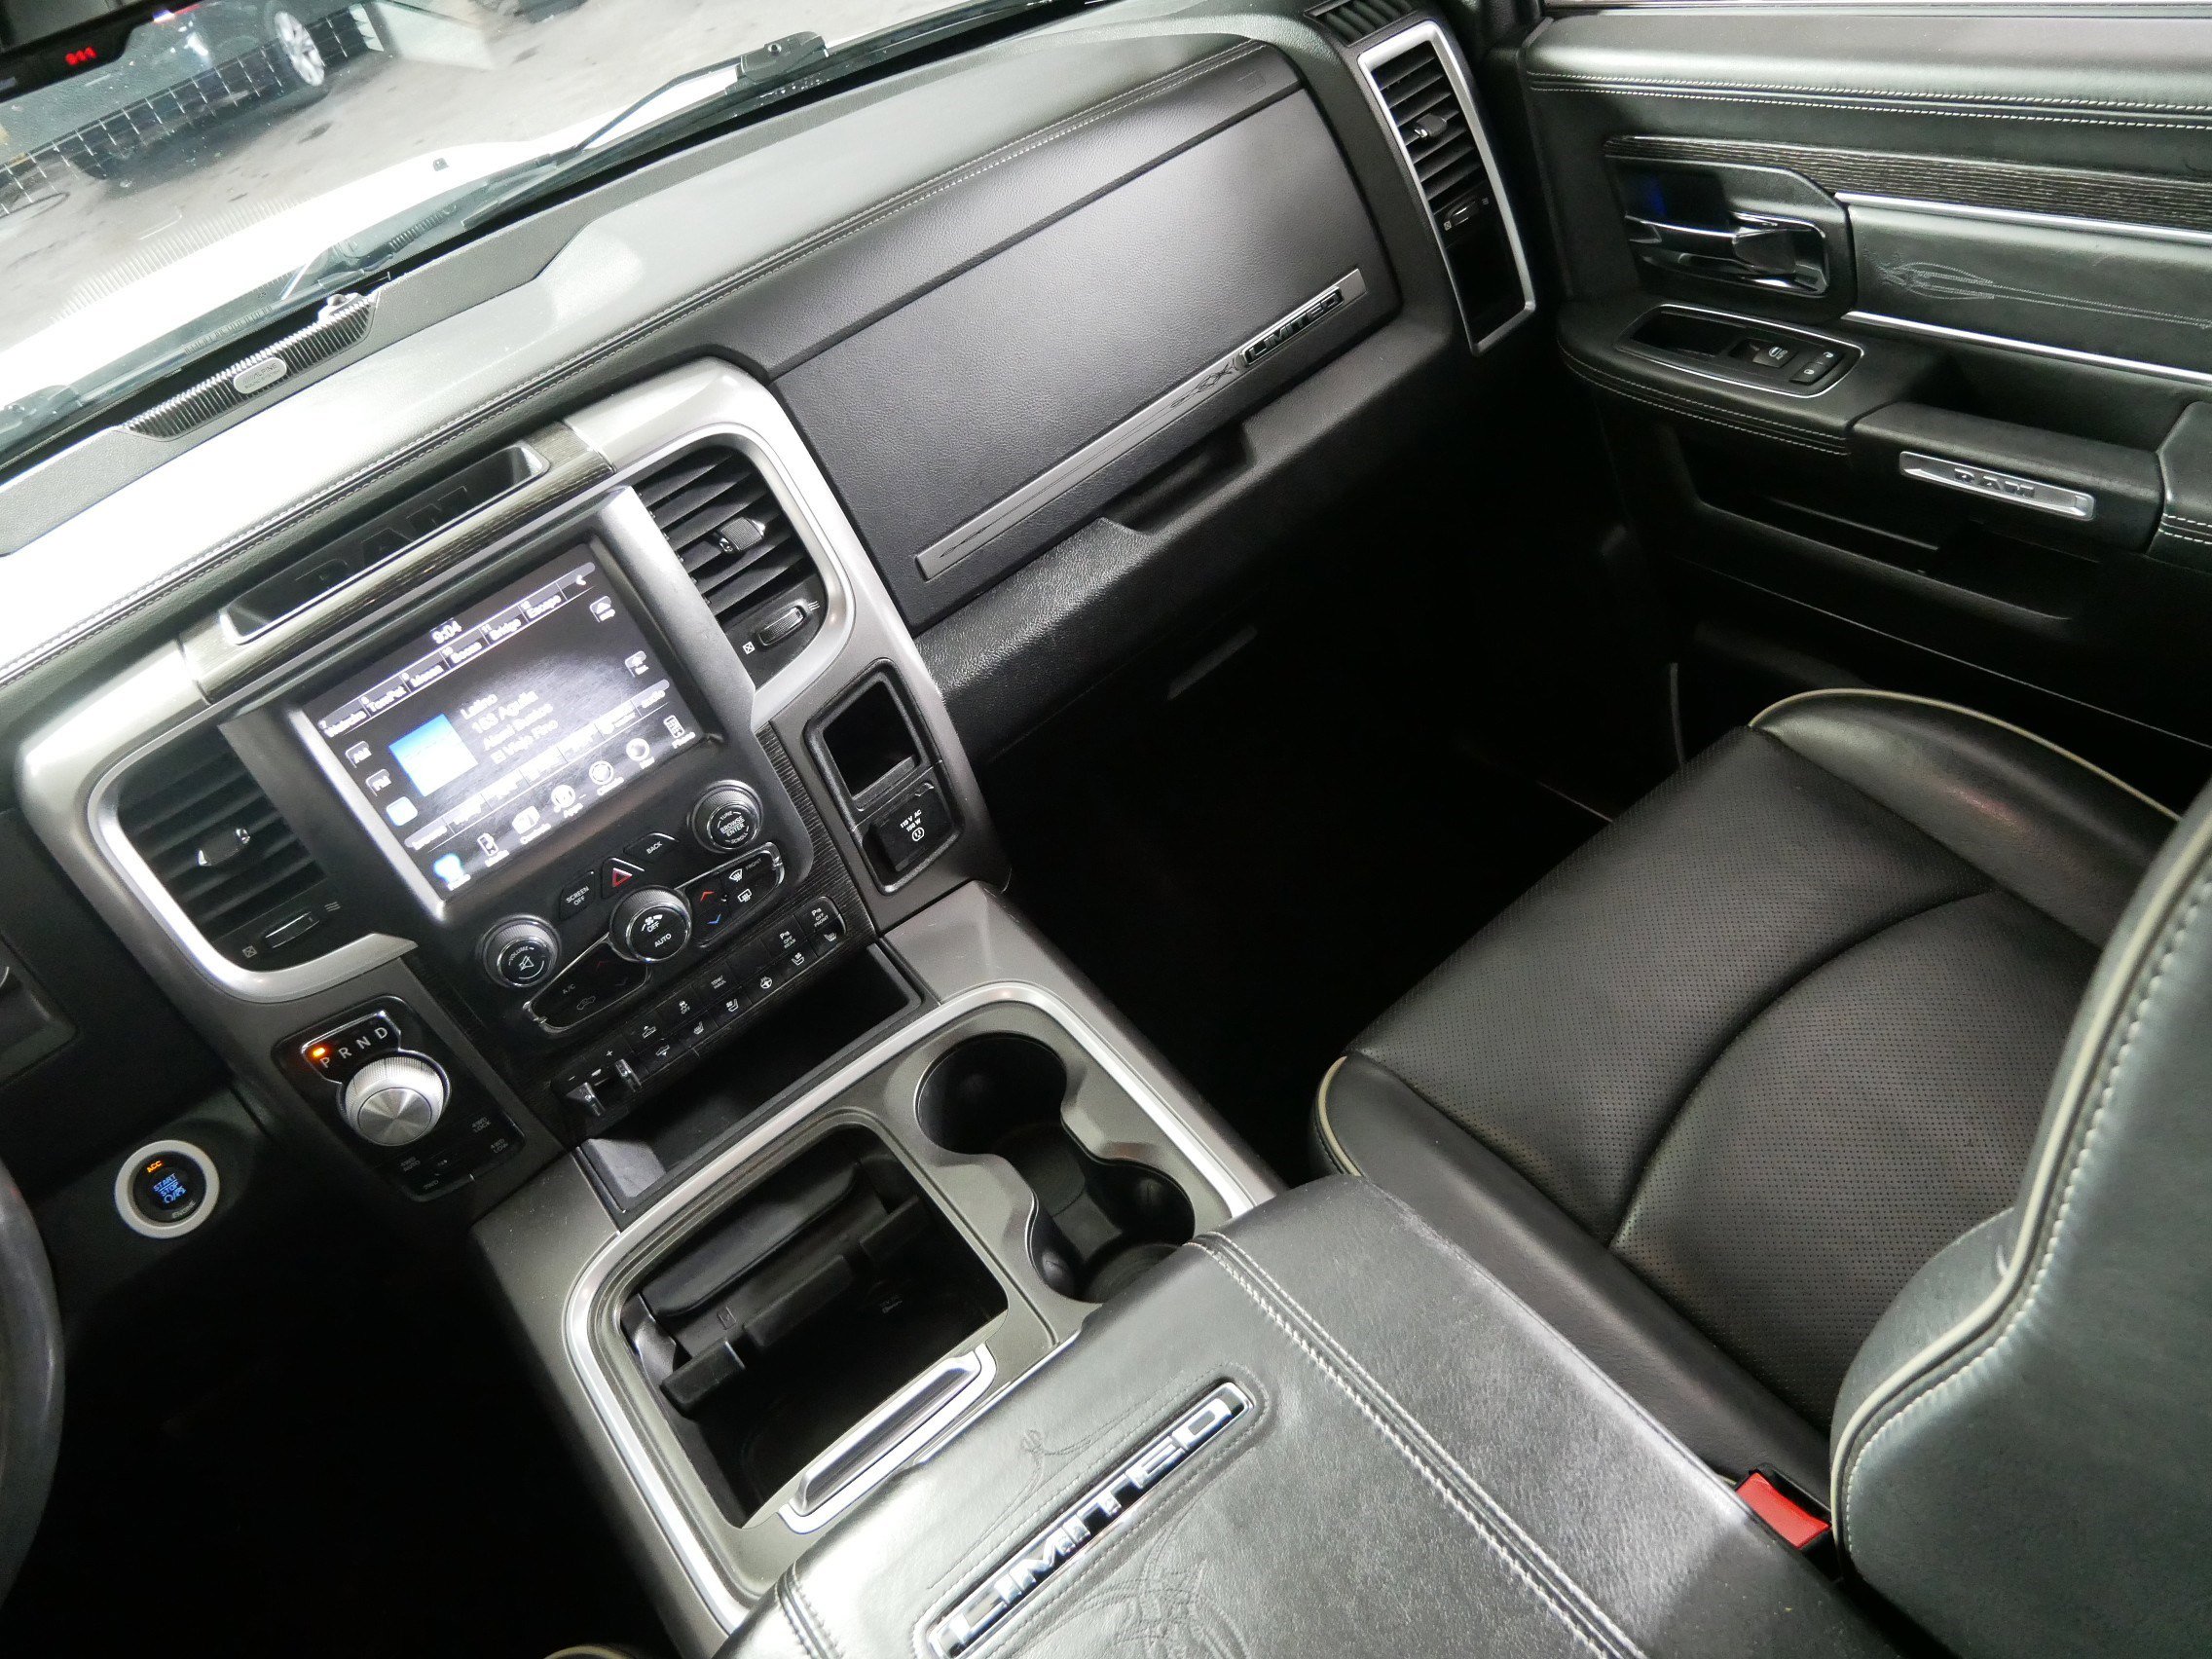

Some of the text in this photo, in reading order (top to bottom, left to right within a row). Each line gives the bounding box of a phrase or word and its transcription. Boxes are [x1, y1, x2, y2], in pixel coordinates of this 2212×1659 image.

[1248, 292, 1340, 360] LIMITED
[1954, 467, 2035, 498] RAM
[527, 595, 562, 619] Escape
[431, 620, 462, 645] 9:04
[489, 618, 522, 641] Bridge
[461, 693, 498, 720] Latino
[671, 731, 696, 750] Phone
[352, 747, 372, 764] AM
[372, 775, 392, 792] FM
[719, 810, 733, 821] TUNE
[914, 809, 921, 818] AC
[719, 815, 746, 834] BROWSE
[725, 823, 745, 837] ENTER
[645, 840, 663, 855] BACK
[745, 858, 762, 870] FRONT
[566, 885, 590, 903] SCREEN
[573, 895, 585, 905] OFF
[646, 920, 660, 933] OFF
[654, 933, 672, 947] AUTO
[783, 935, 793, 944] OFF
[508, 945, 530, 962] VOLUME
[562, 983, 576, 994] A/C
[319, 1027, 388, 1069] P R N D
[473, 1121, 491, 1132] LOCK
[146, 1161, 164, 1173] ACC
[153, 1173, 176, 1192] START
[160, 1181, 179, 1197] STOP
[948, 1397, 1234, 1645] LIMITED
